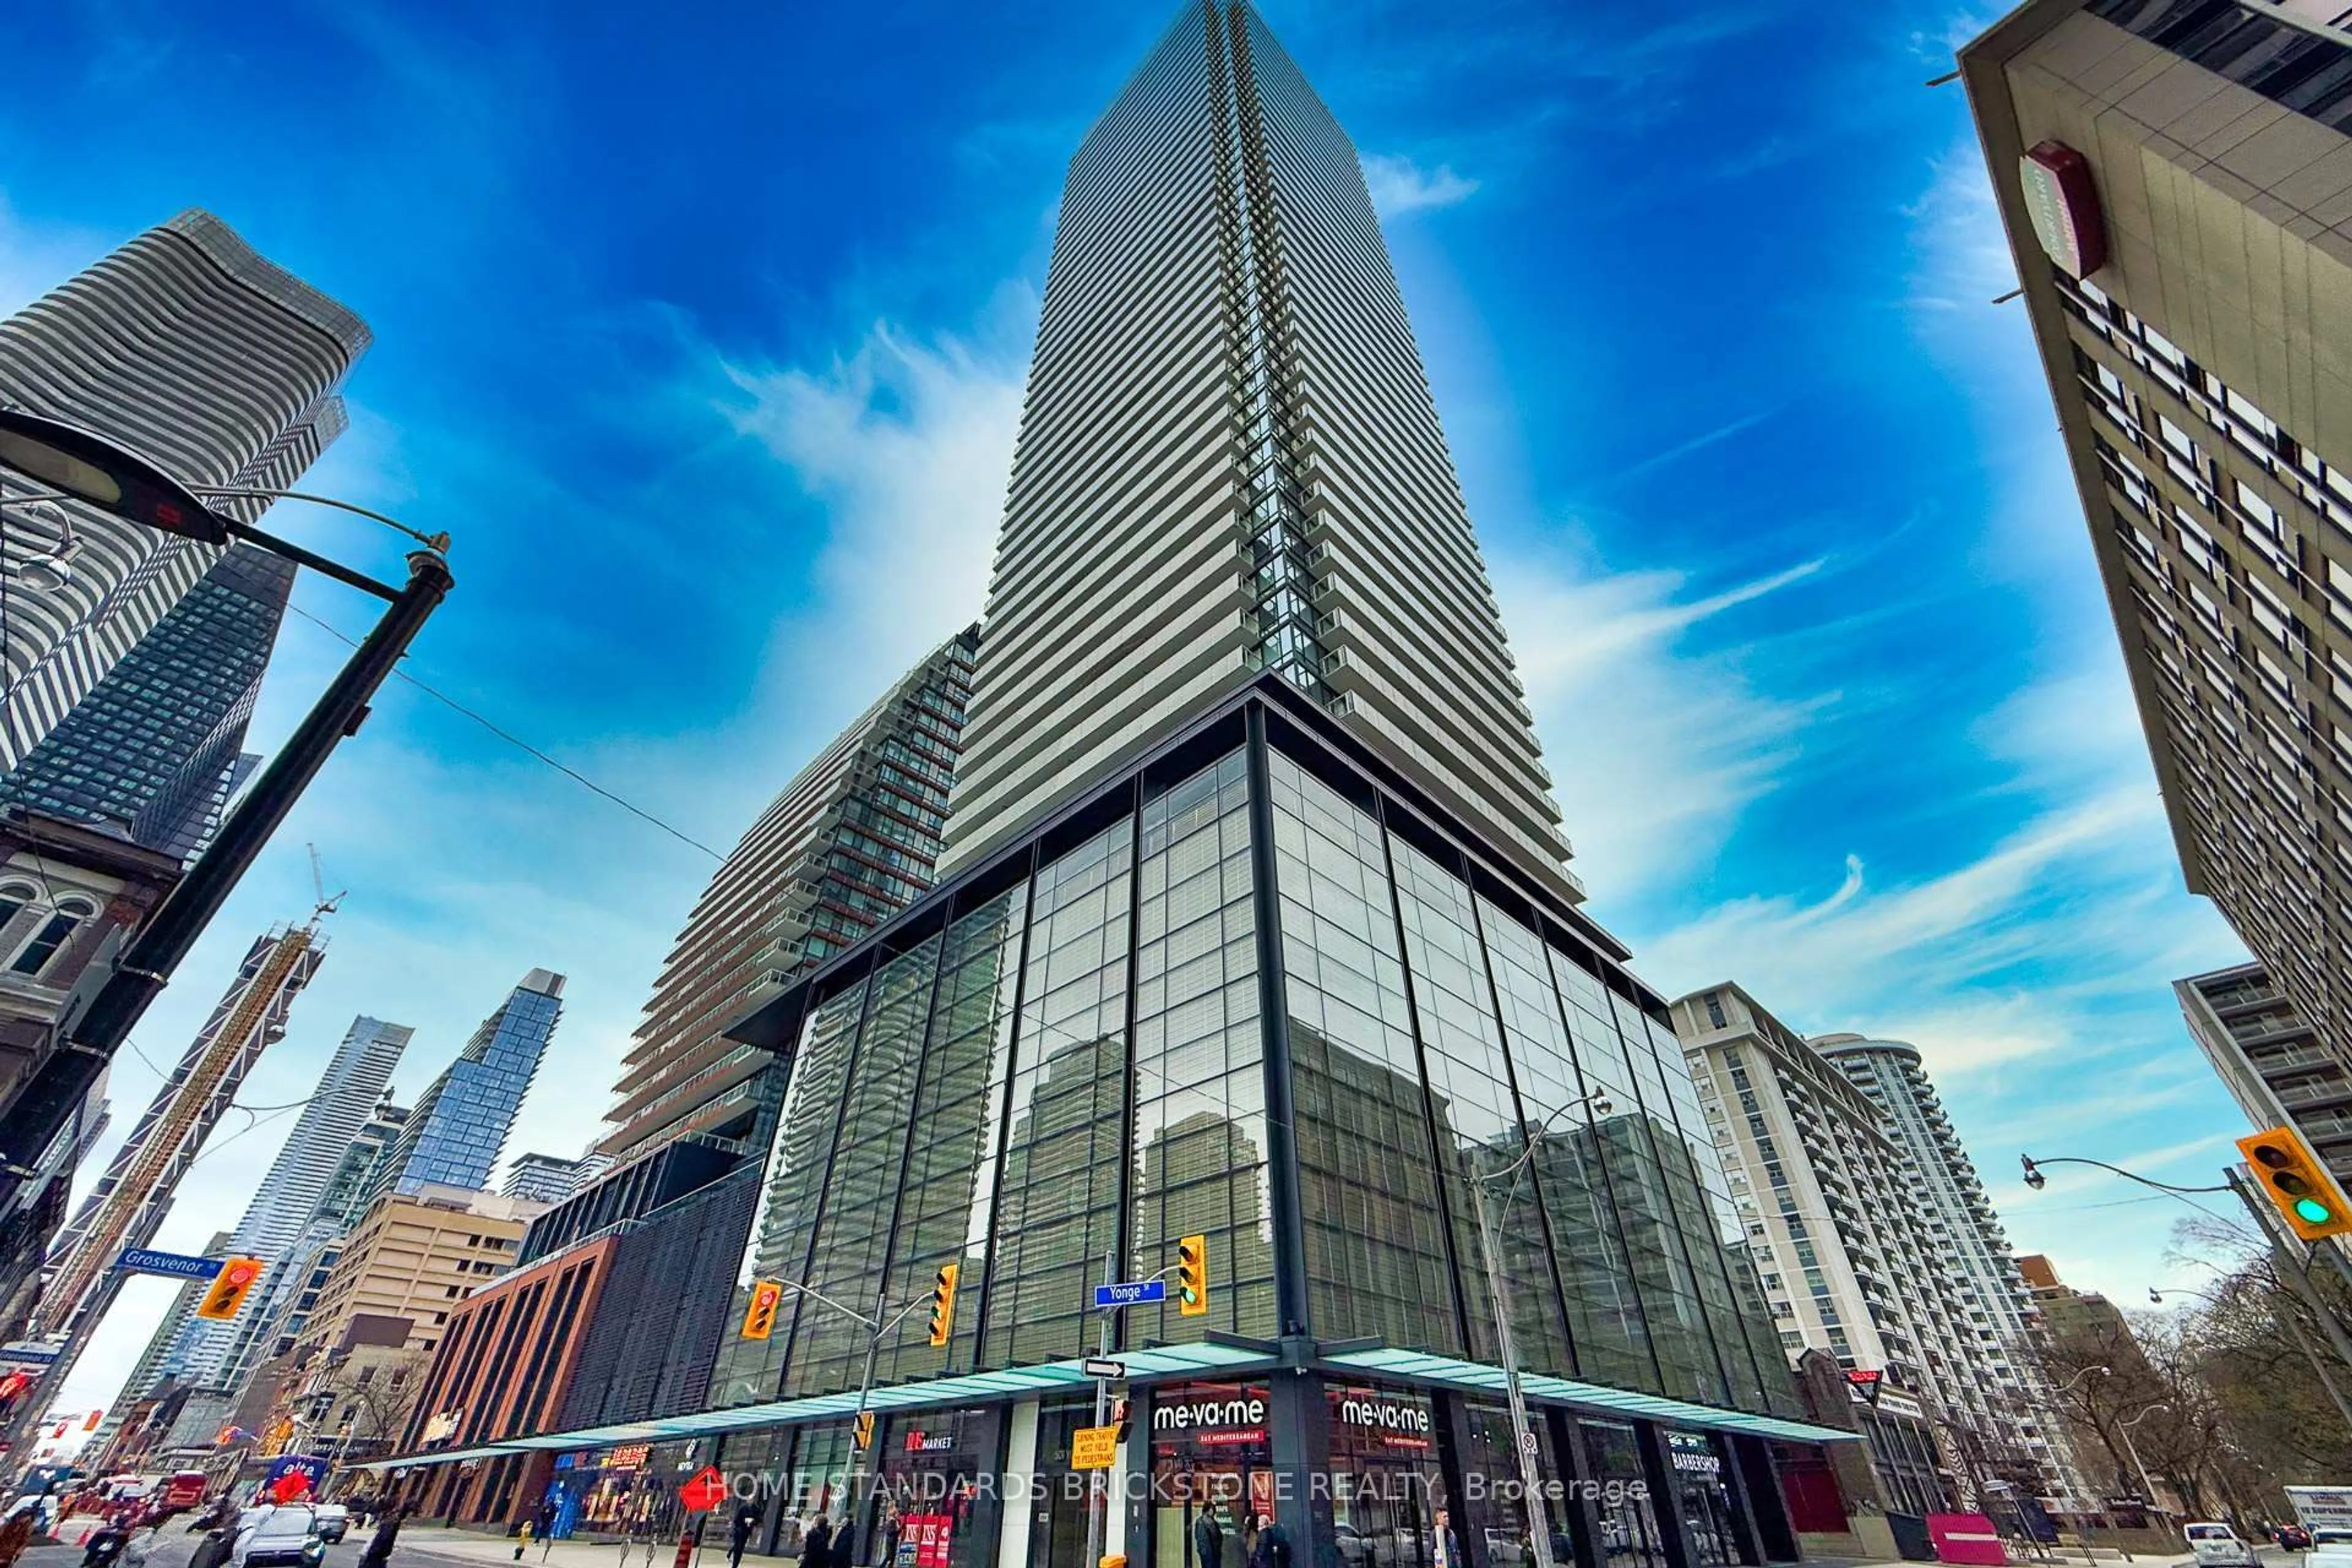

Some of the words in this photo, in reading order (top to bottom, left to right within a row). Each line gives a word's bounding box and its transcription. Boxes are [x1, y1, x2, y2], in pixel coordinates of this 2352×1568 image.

[125, 1250, 204, 1273] Grosvenor
[1110, 1287, 1140, 1301] Yonge
[922, 1436, 951, 1450] MARKET
[1672, 1452, 1719, 1473] BARBERSHOP
